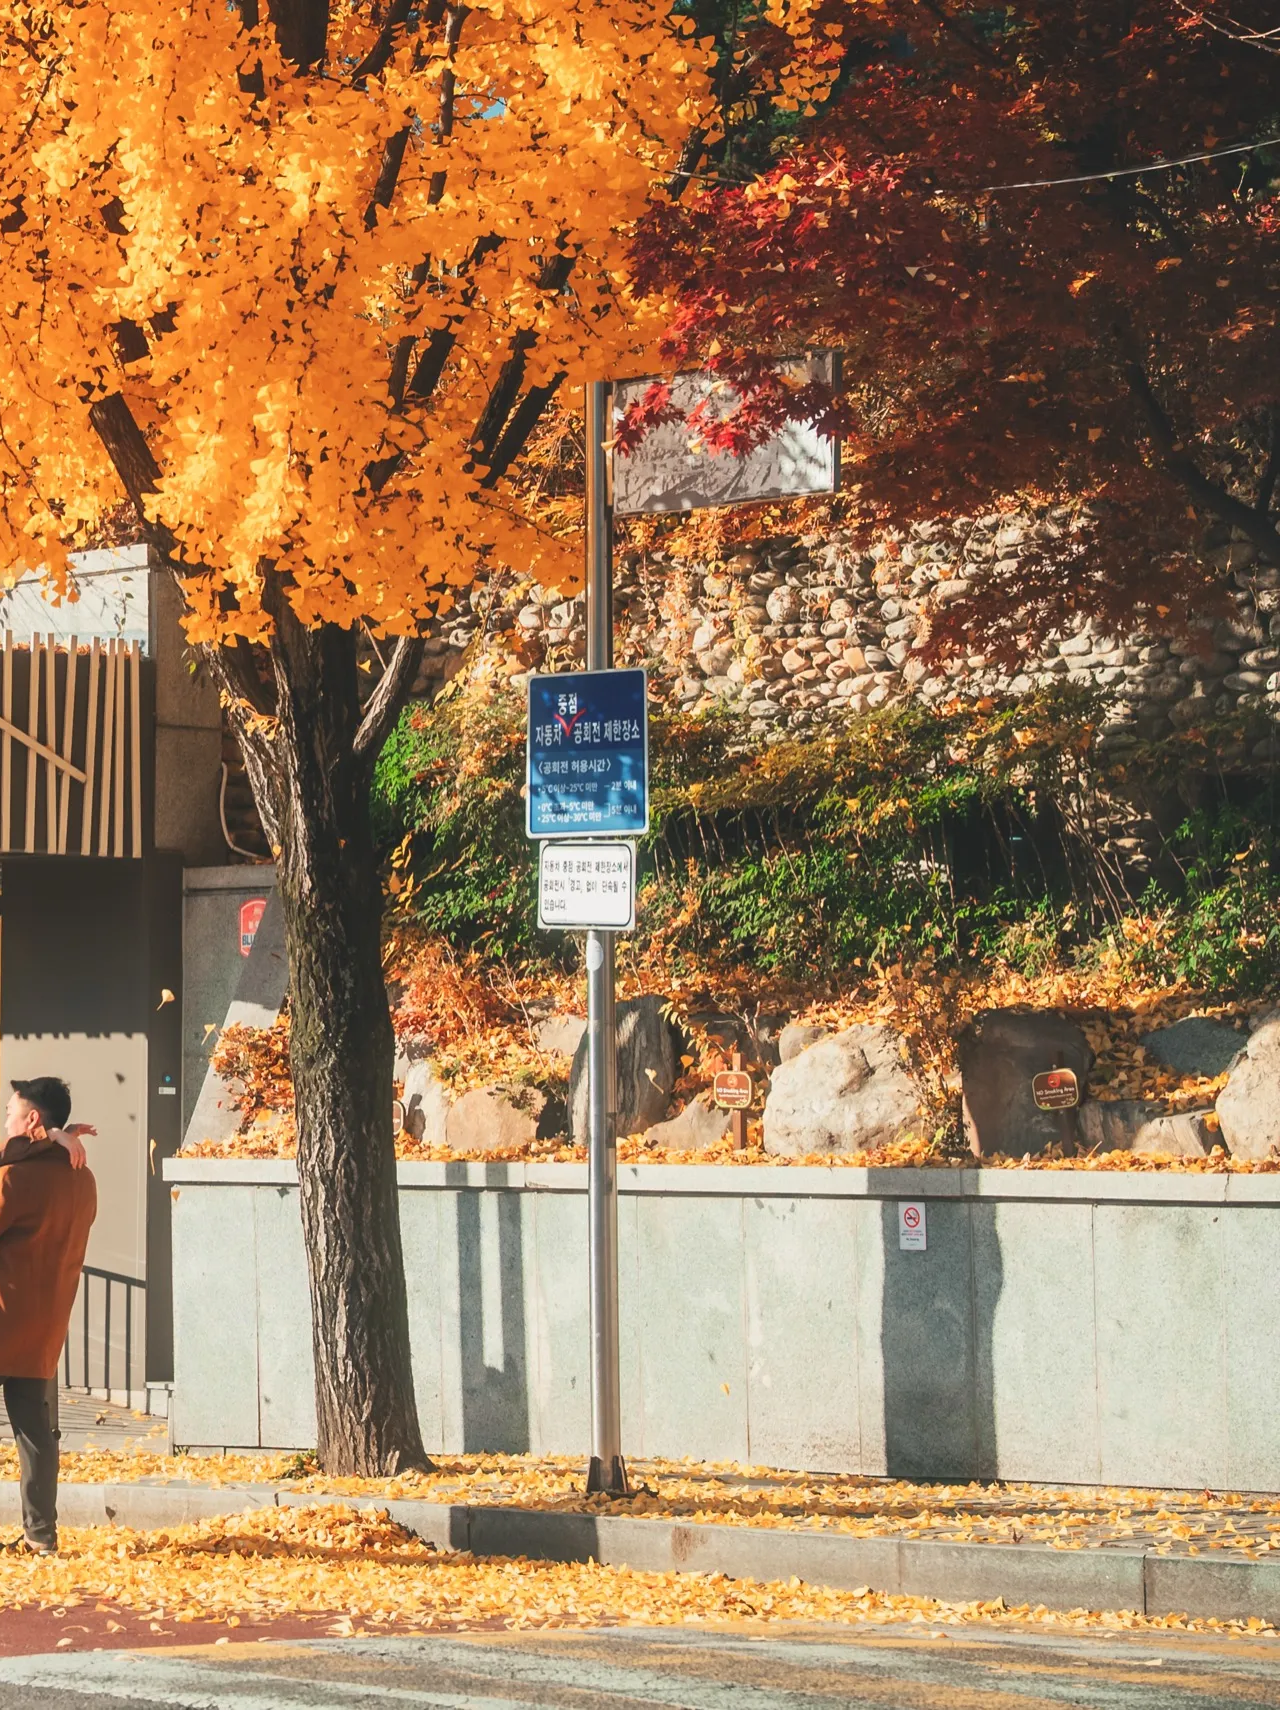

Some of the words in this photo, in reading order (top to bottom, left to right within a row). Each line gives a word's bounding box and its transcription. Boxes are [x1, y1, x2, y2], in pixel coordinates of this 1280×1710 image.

[558, 692, 578, 716] 중점
[535, 723, 562, 747] 자동차
[573, 721, 601, 744] 공회전
[603, 719, 640, 742] 제한장소
[544, 860, 560, 873] 자동차
[621, 881, 627, 892] 수
